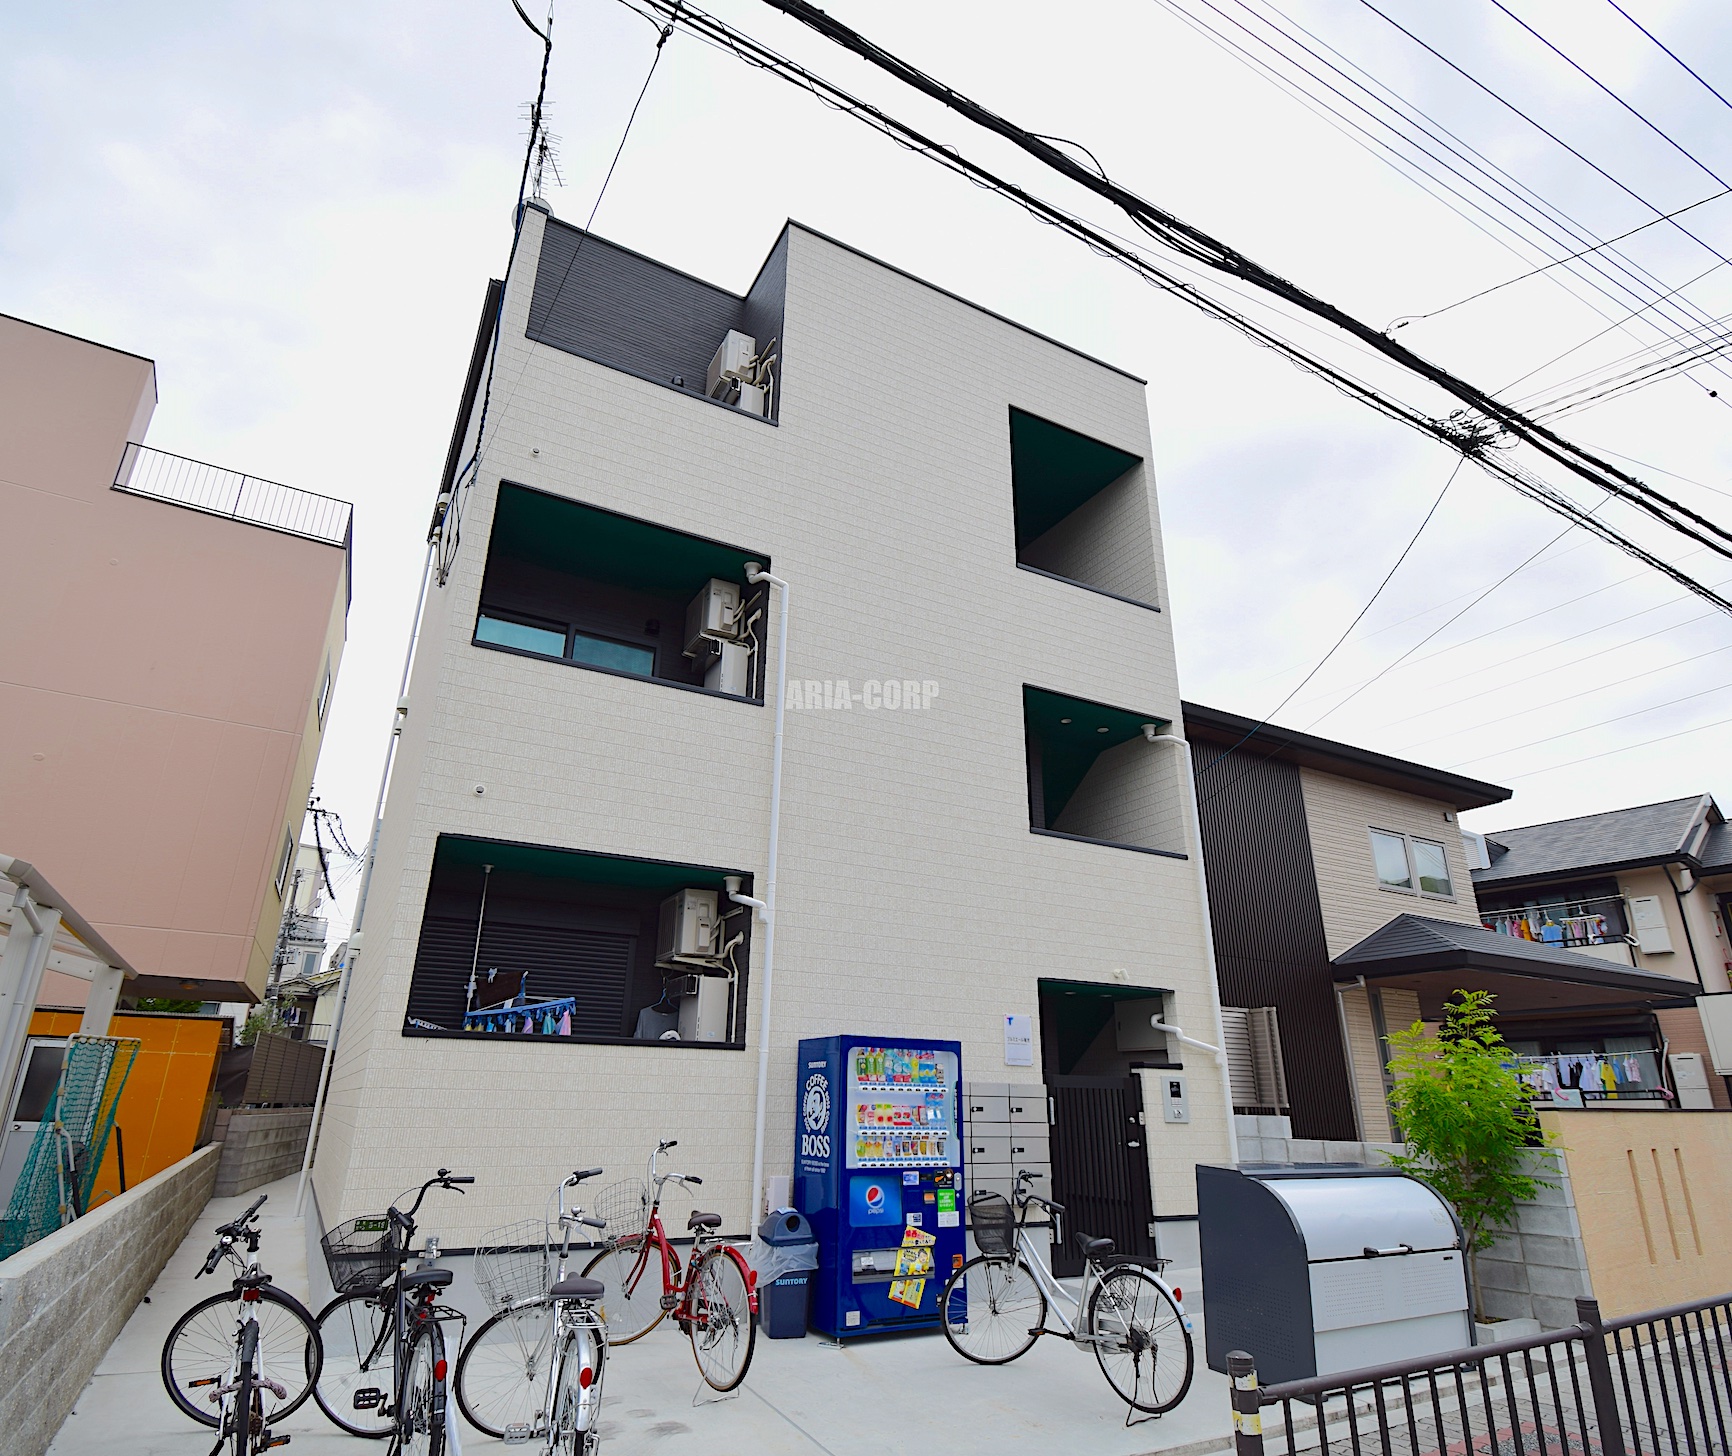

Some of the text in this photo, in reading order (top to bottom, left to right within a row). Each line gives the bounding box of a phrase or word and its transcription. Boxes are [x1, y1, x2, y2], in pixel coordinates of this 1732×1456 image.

[806, 1073, 829, 1092] COFFEE
[801, 1134, 831, 1159] BOSS
[775, 1277, 808, 1286] SUNTORY
